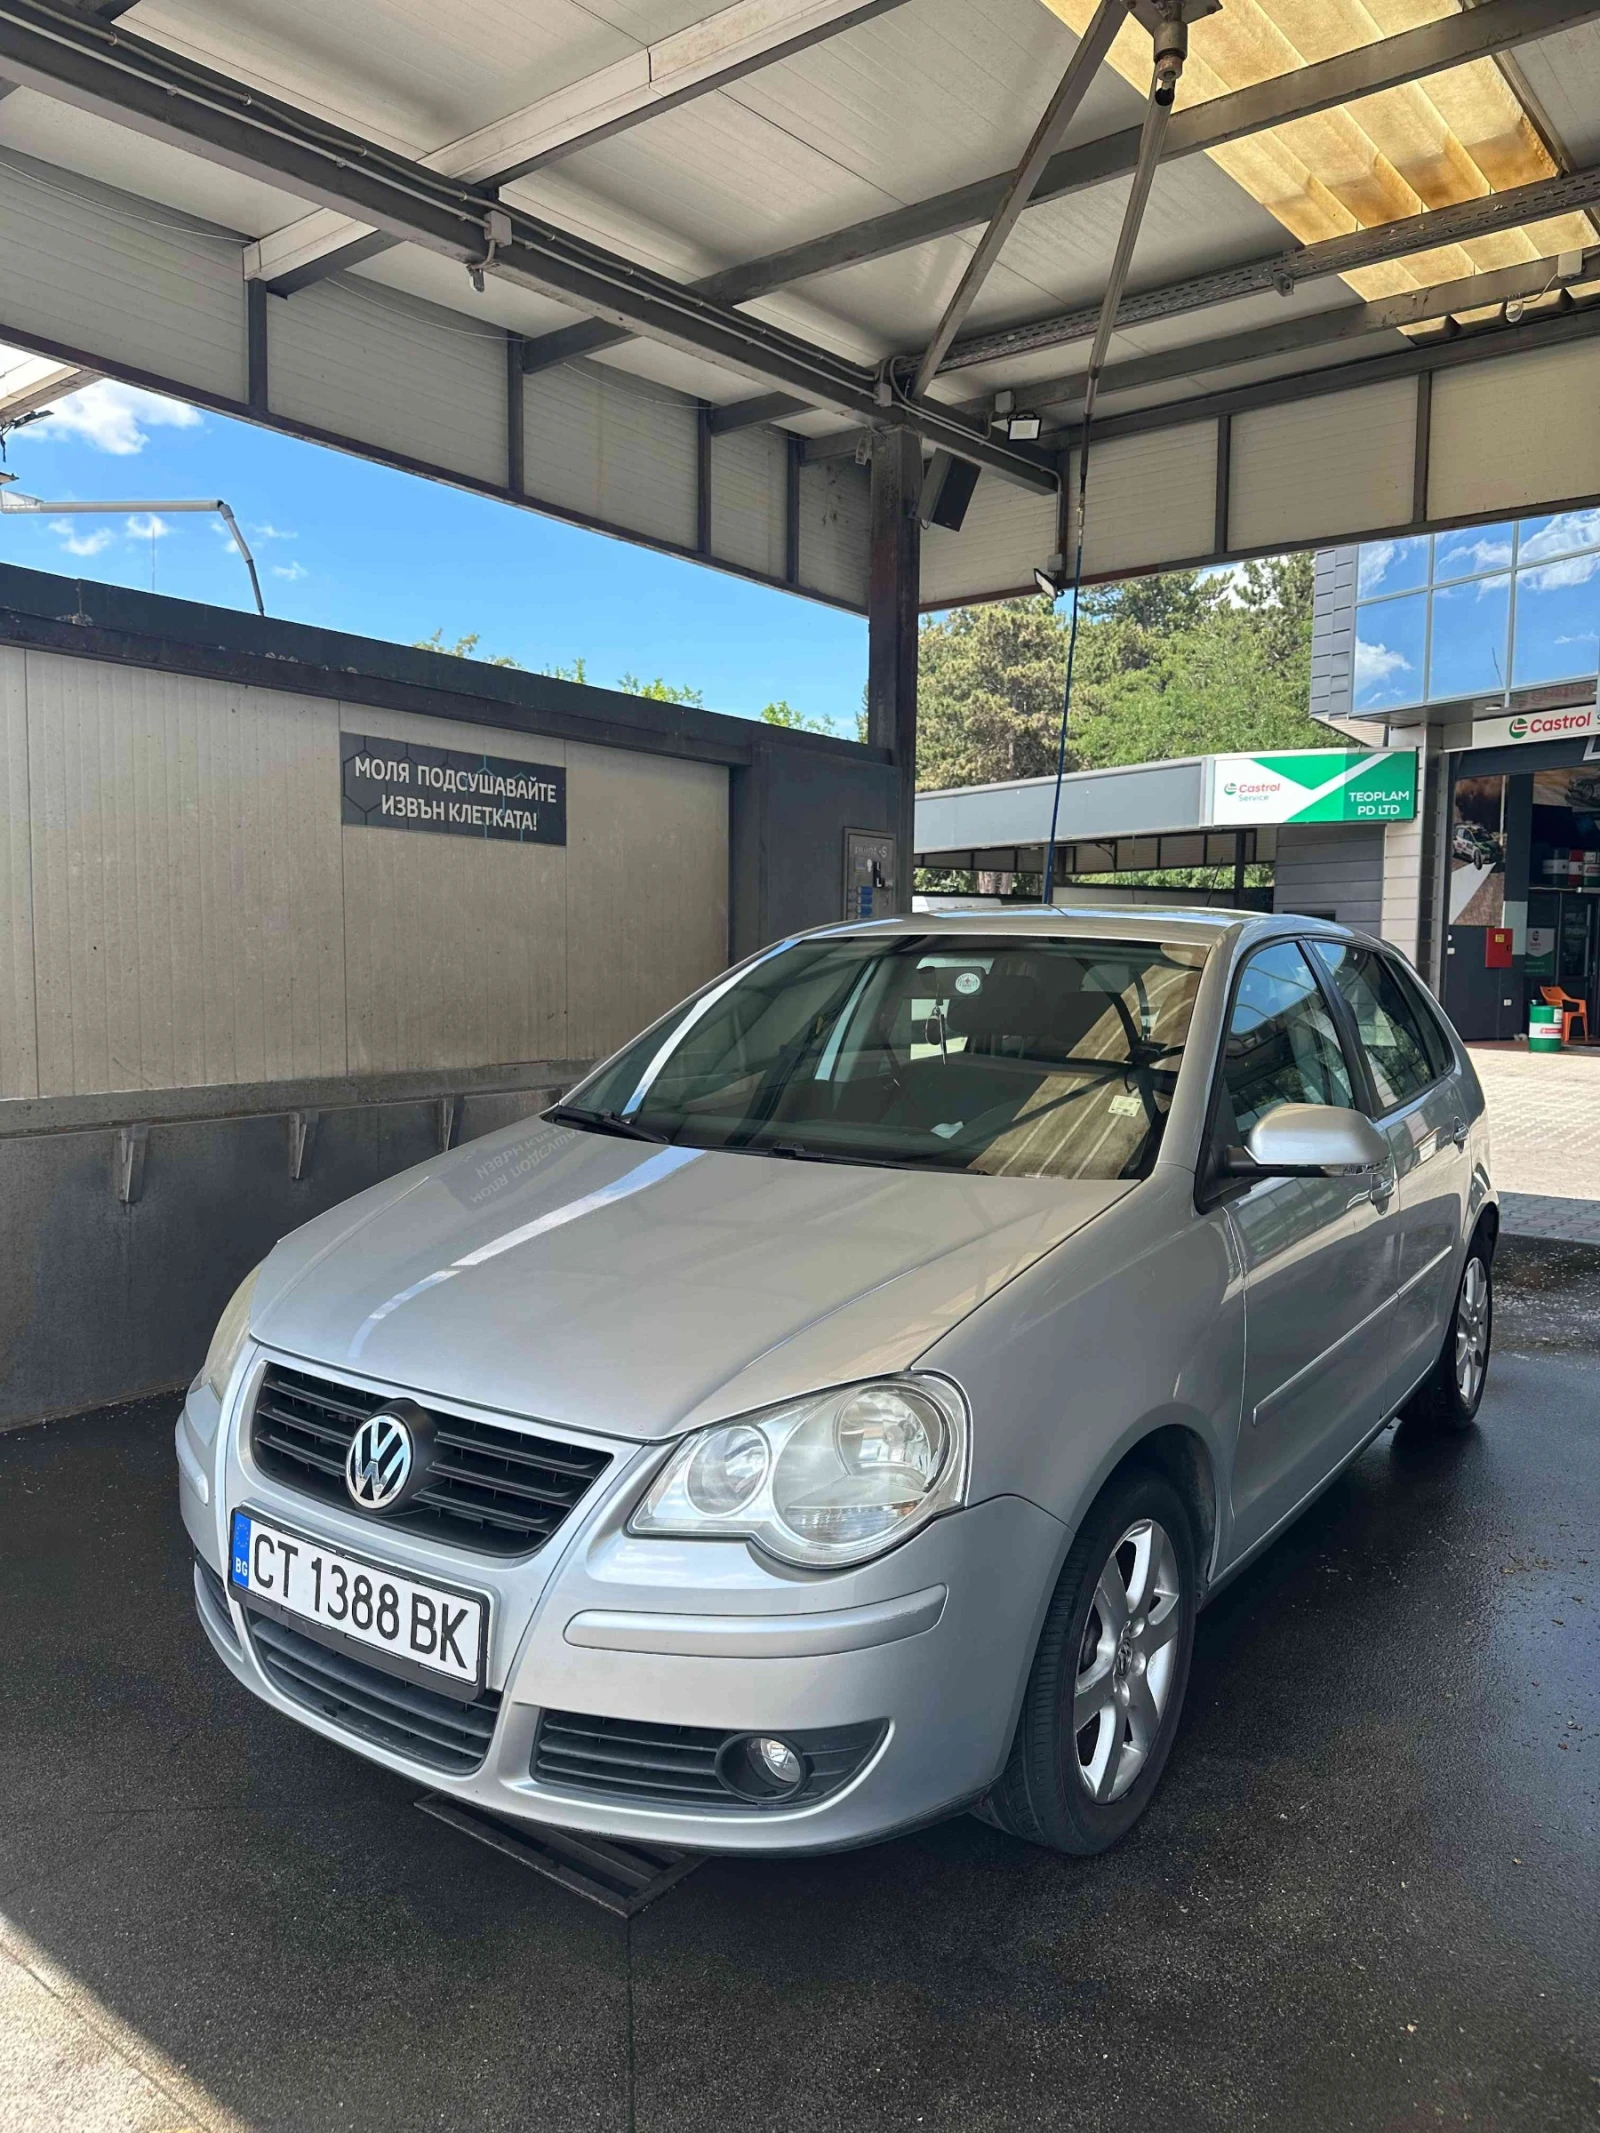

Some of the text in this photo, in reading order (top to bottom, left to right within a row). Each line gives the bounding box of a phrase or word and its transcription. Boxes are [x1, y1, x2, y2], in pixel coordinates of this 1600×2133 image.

[1530, 711, 1592, 733] Castrol
[355, 756, 557, 803] МОЛЯ ПОДСУШАВАЙТЕ
[1239, 782, 1281, 794] Castrol
[1238, 794, 1269, 802] Service
[1349, 791, 1410, 803] TEOPLAM
[381, 795, 538, 831] ИЗВЪН КЛЕТКАТА!
[1357, 804, 1400, 816] PD LTD
[234, 1556, 248, 1577] BG
[254, 1533, 469, 1670] CT 1388 BK
